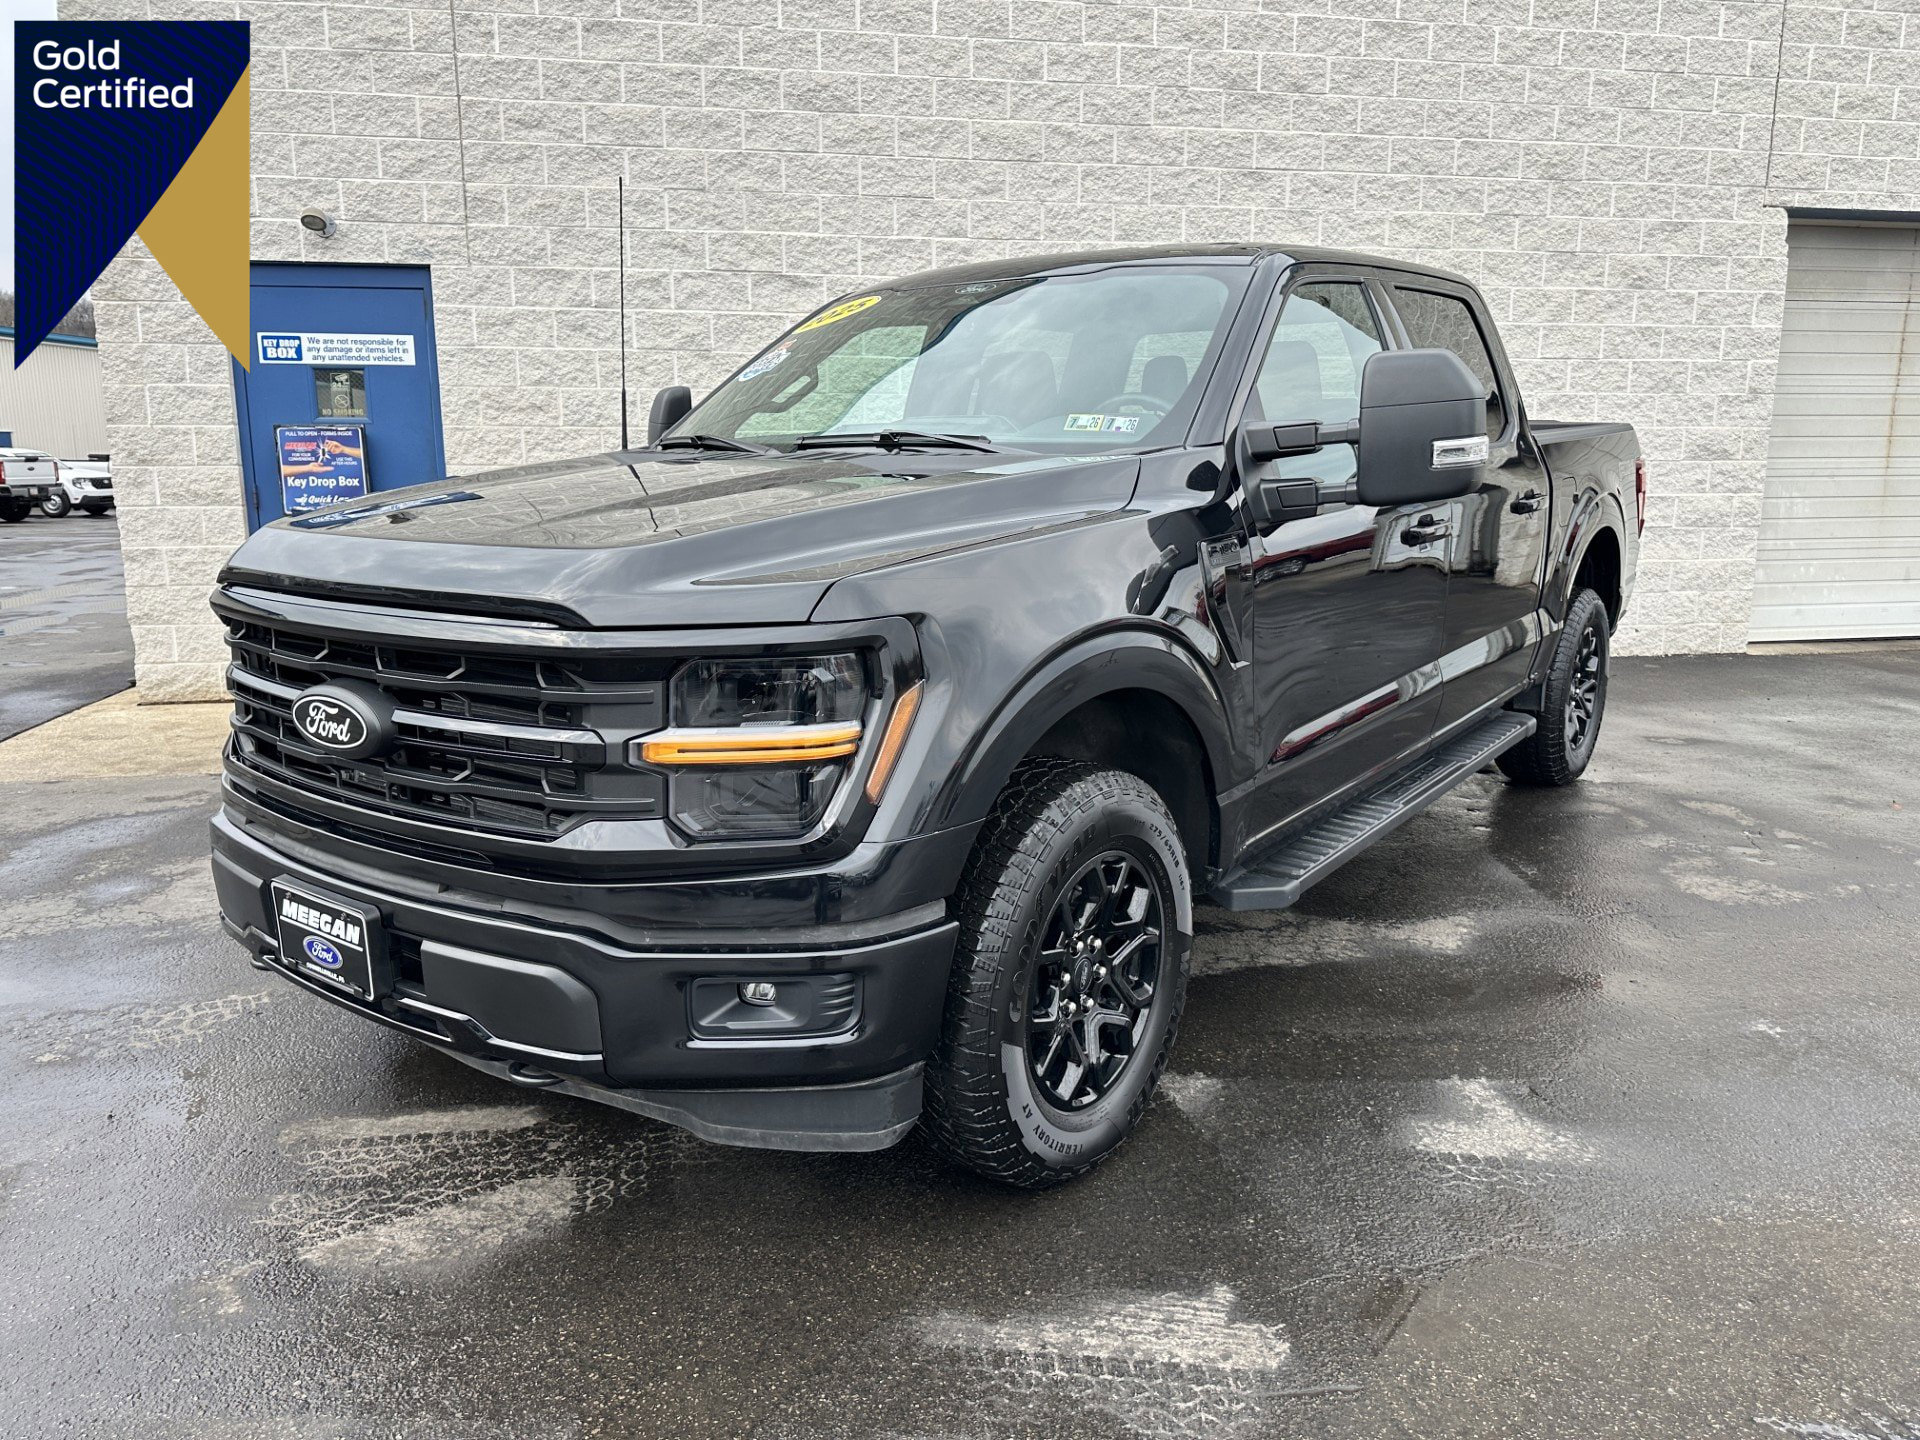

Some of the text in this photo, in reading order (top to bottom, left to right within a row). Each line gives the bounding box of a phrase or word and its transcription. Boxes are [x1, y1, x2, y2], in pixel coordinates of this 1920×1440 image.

[263, 339, 299, 347] KEY DROP
[307, 336, 320, 345] We
[351, 338, 393, 347] responsible
[396, 338, 407, 346] for
[266, 347, 298, 359] BOX
[306, 346, 321, 354] any
[323, 346, 352, 354] damage
[365, 346, 385, 354] items
[388, 346, 400, 354] left
[312, 353, 404, 362] any unattended vehicles.
[322, 408, 364, 416] NO SMOKING
[1089, 417, 1100, 428] 26
[1126, 419, 1137, 430] 26
[287, 476, 359, 489] Key Drop Box
[308, 495, 331, 504] Quick
[306, 702, 350, 742] Ford
[282, 898, 360, 945] MEEGAN
[311, 941, 334, 962] Ford
[1022, 1103, 1083, 1156] TERRITORY AT
